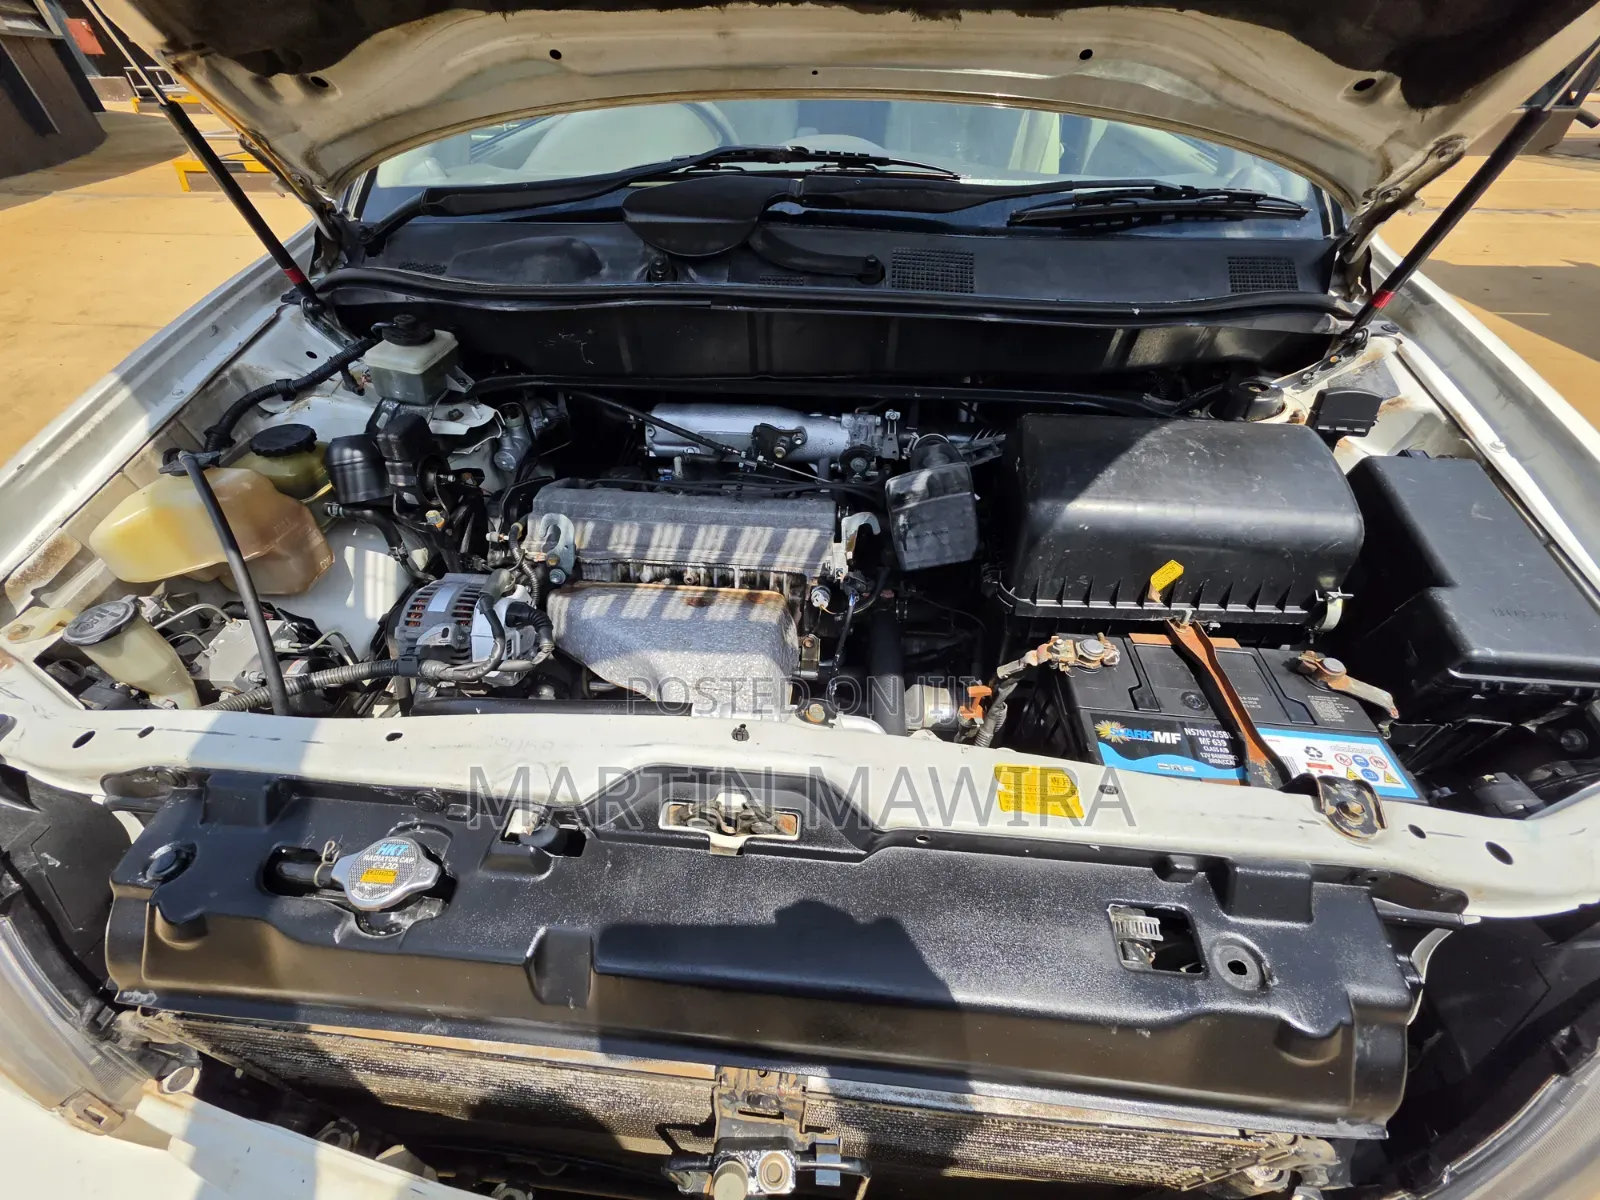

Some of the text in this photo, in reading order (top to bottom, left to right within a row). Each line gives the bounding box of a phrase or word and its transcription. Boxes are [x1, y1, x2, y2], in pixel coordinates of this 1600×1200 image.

[1198, 737, 1227, 747] MF 639
[375, 843, 409, 856] HKT
